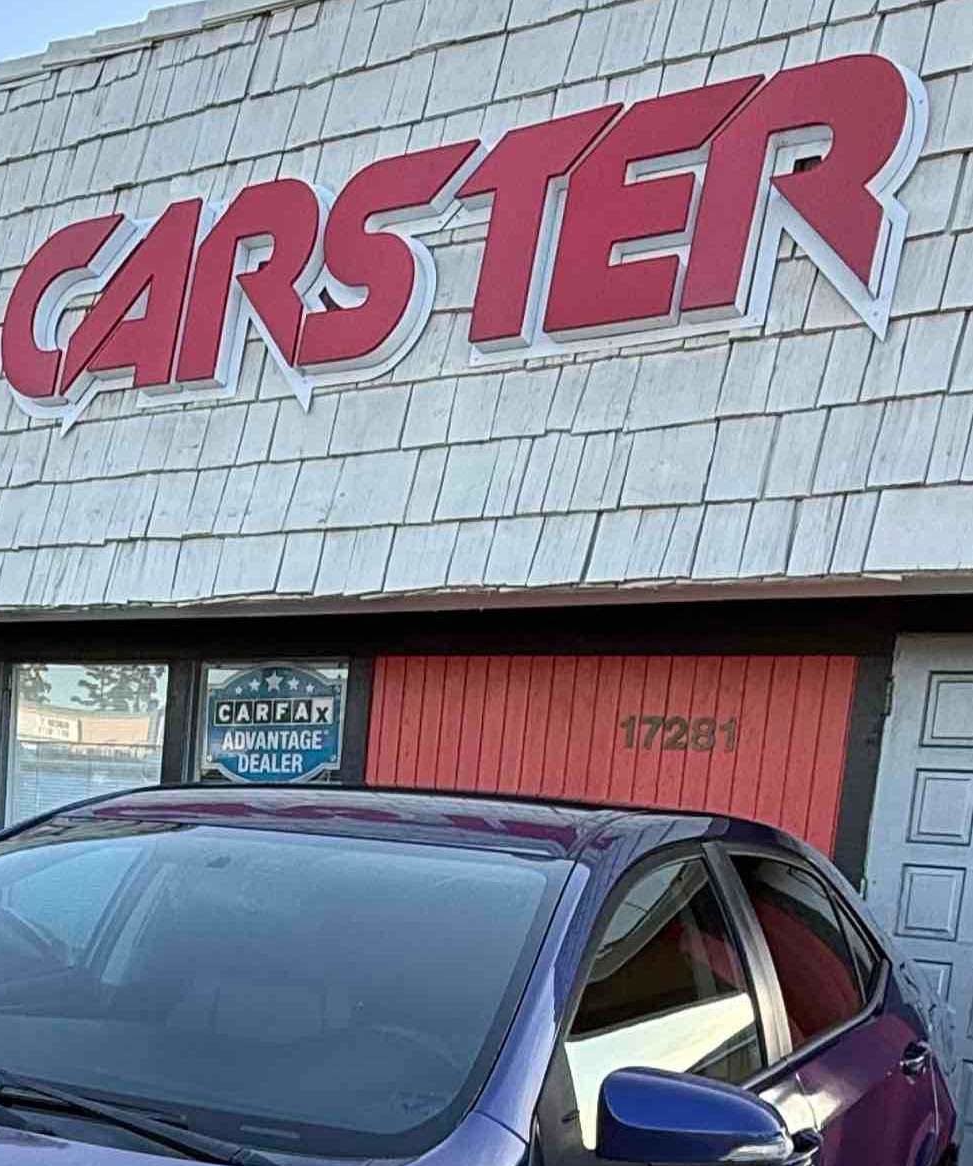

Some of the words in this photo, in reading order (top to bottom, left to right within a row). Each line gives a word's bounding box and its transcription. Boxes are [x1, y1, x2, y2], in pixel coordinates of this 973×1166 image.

[1, 53, 912, 400] CARSTER
[217, 701, 330, 723] CARFAX
[222, 730, 323, 751] ADVANTAGE
[620, 715, 736, 752] 17281
[238, 753, 303, 773] DEALER
